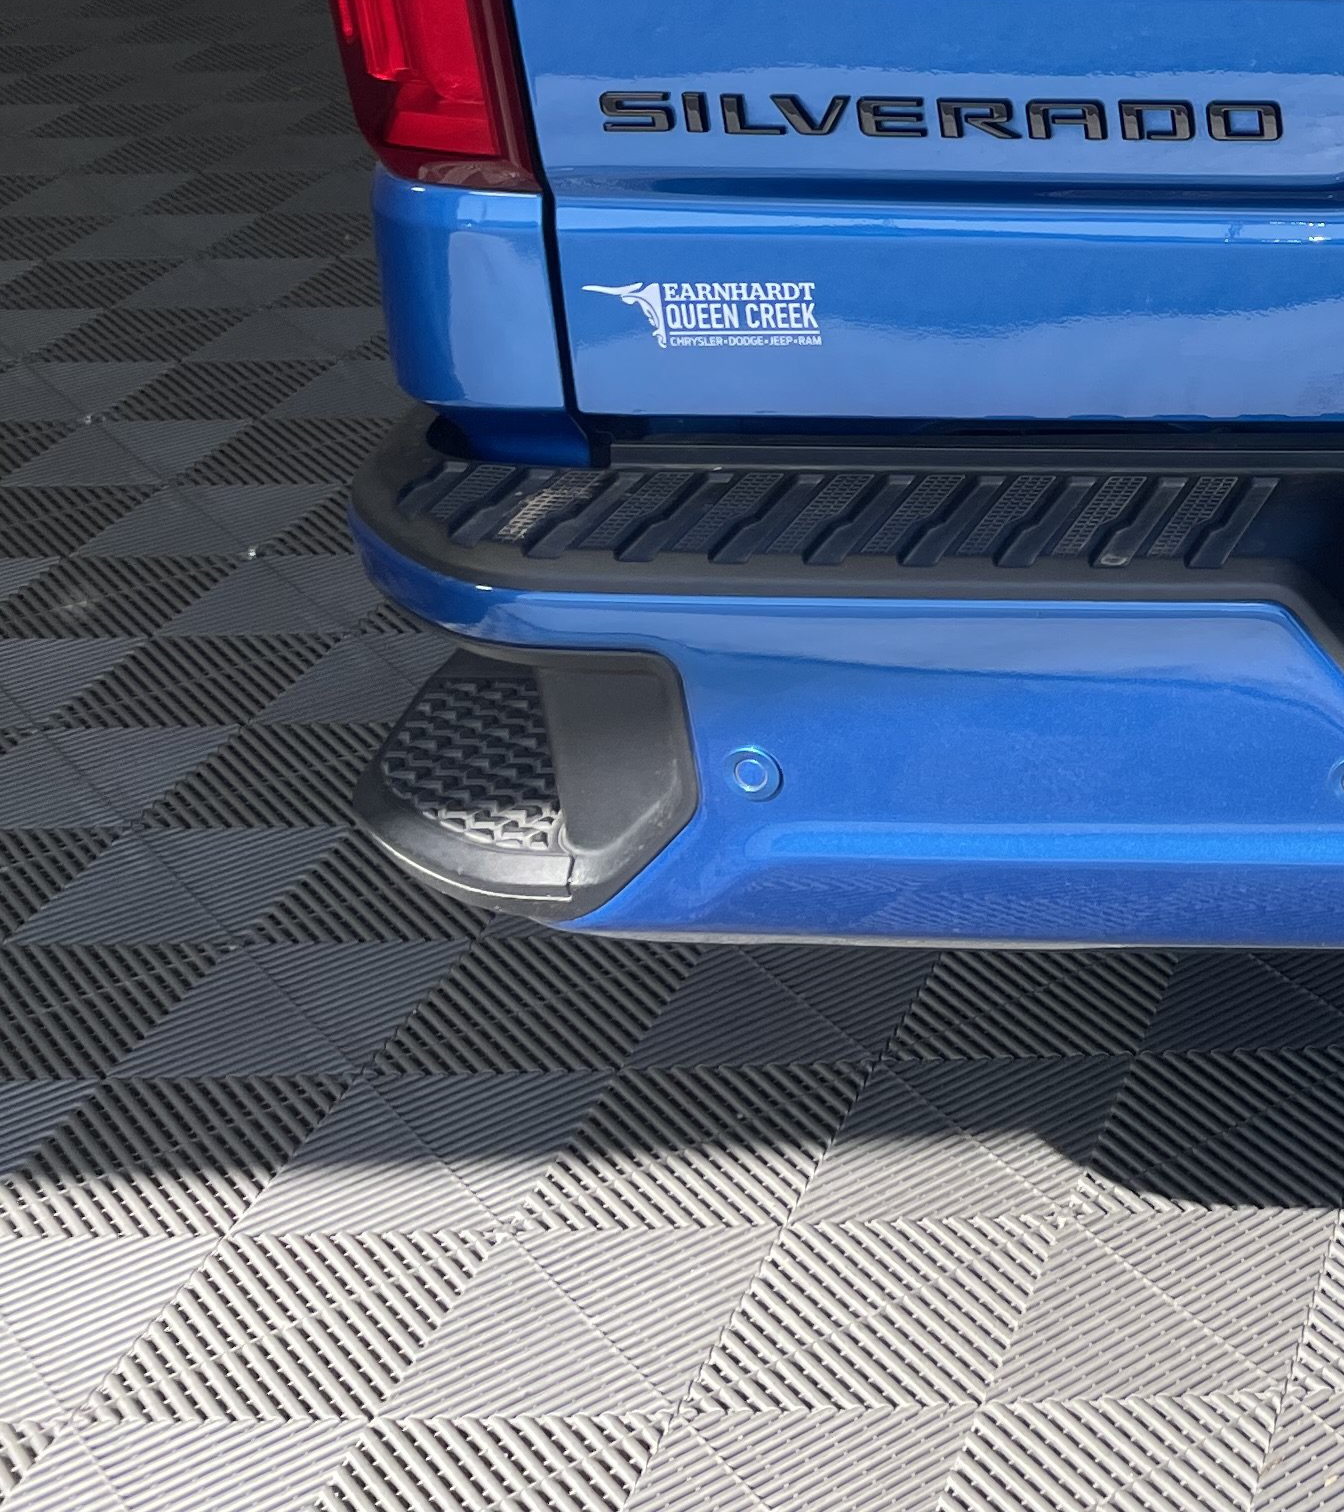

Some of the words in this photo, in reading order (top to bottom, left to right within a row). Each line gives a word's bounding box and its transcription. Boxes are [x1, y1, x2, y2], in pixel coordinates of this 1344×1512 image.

[599, 90, 1284, 142] SILVERADO
[663, 282, 815, 301] EARNHARDT
[666, 303, 738, 330] QUEEN
[745, 303, 819, 329] CREEK
[670, 336, 723, 346] CHRYSLER
[728, 336, 764, 346] DODGE
[769, 336, 793, 346] JEEP
[798, 336, 822, 346] RAM
